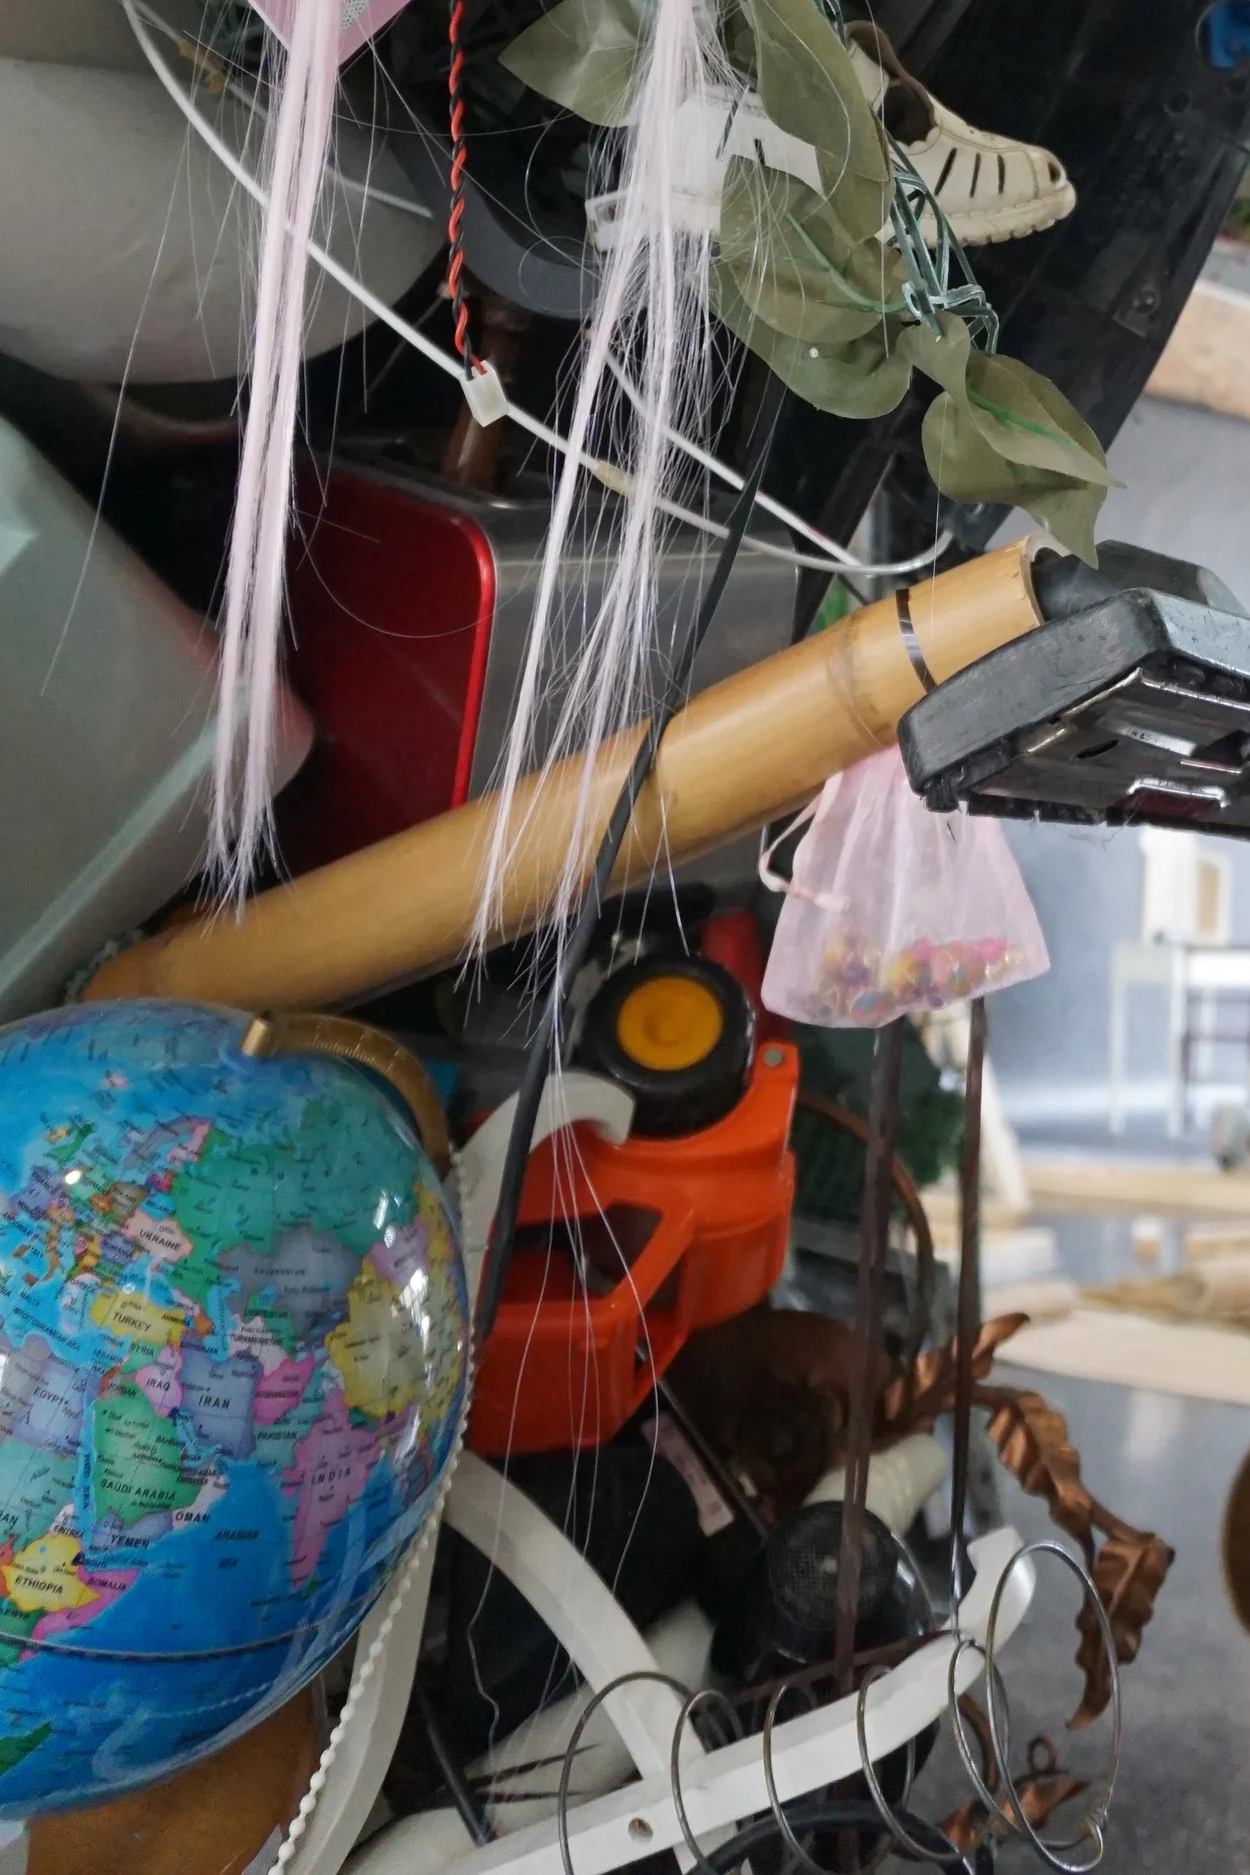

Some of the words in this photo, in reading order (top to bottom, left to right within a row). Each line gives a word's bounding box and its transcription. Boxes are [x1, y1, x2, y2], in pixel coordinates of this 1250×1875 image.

[139, 1228, 181, 1251] UKRAINE
[113, 1311, 152, 1333] TURKEY
[146, 1377, 171, 1392] IRAQ
[33, 1385, 65, 1406] EGYPT
[198, 1394, 231, 1410] IRAN
[311, 1467, 352, 1485] INDIA
[101, 1477, 133, 1495] SAUDI
[134, 1485, 177, 1502] ARABIA
[174, 1511, 210, 1524] OMAN
[110, 1533, 151, 1549] YEMEN
[14, 1575, 64, 1595] ETHIOPIA
